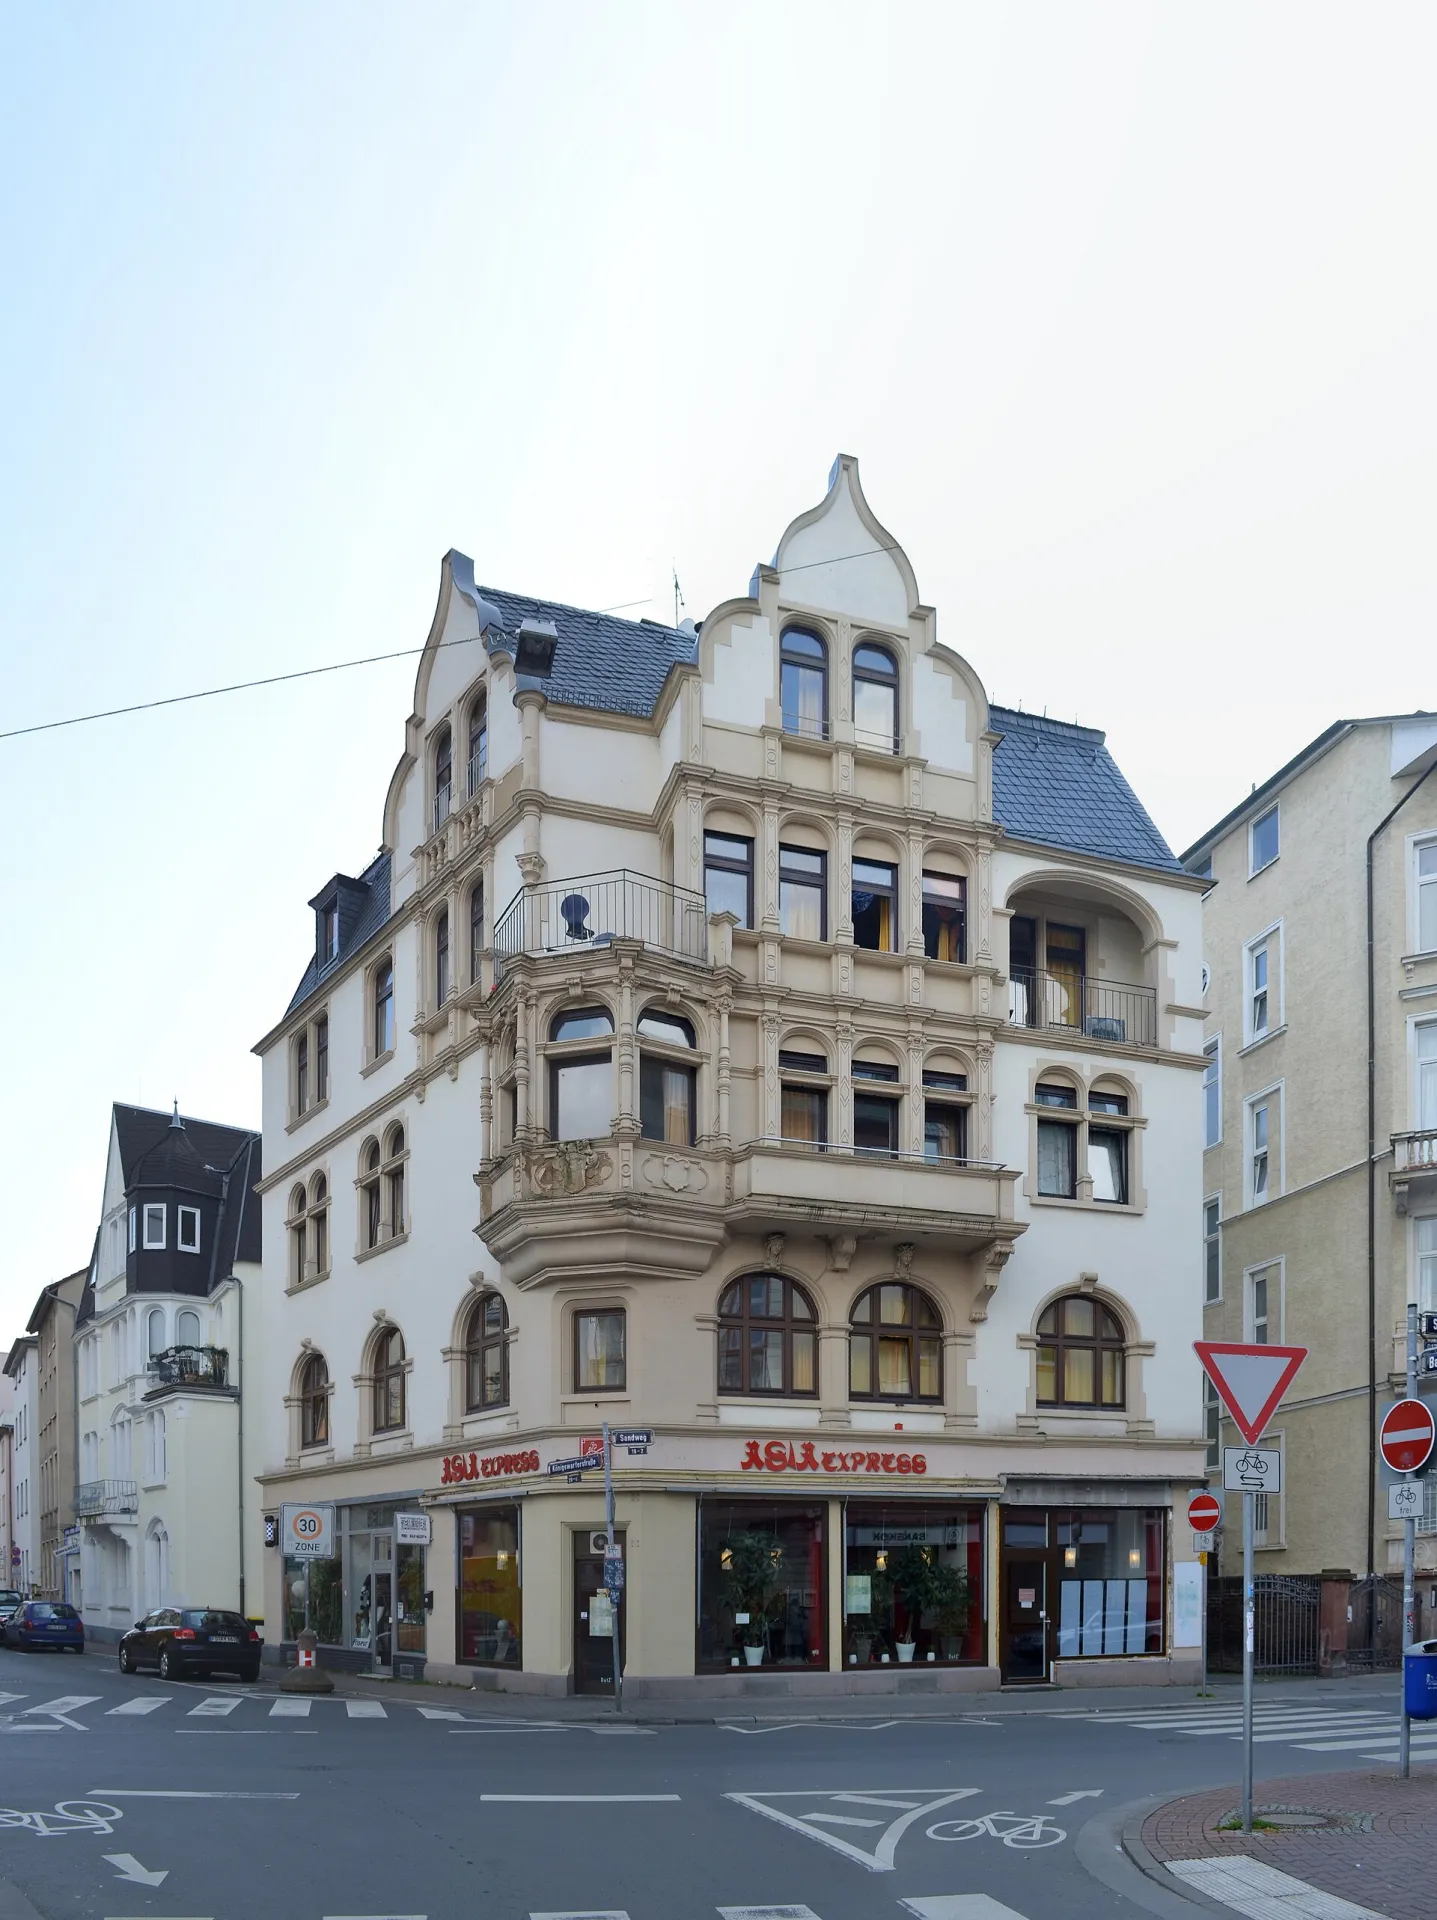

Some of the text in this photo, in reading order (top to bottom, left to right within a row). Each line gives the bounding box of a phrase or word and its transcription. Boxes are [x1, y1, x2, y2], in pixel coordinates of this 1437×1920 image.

[620, 1434, 647, 1443] Sandweg
[740, 1440, 927, 1475] ASIA EXPRESS
[441, 1449, 540, 1485] ASIA EXPRESS
[551, 1458, 597, 1473] Königswarterstraße
[1399, 1506, 1412, 1514] frei
[299, 1518, 316, 1533] 30
[295, 1542, 320, 1551] ZONE
